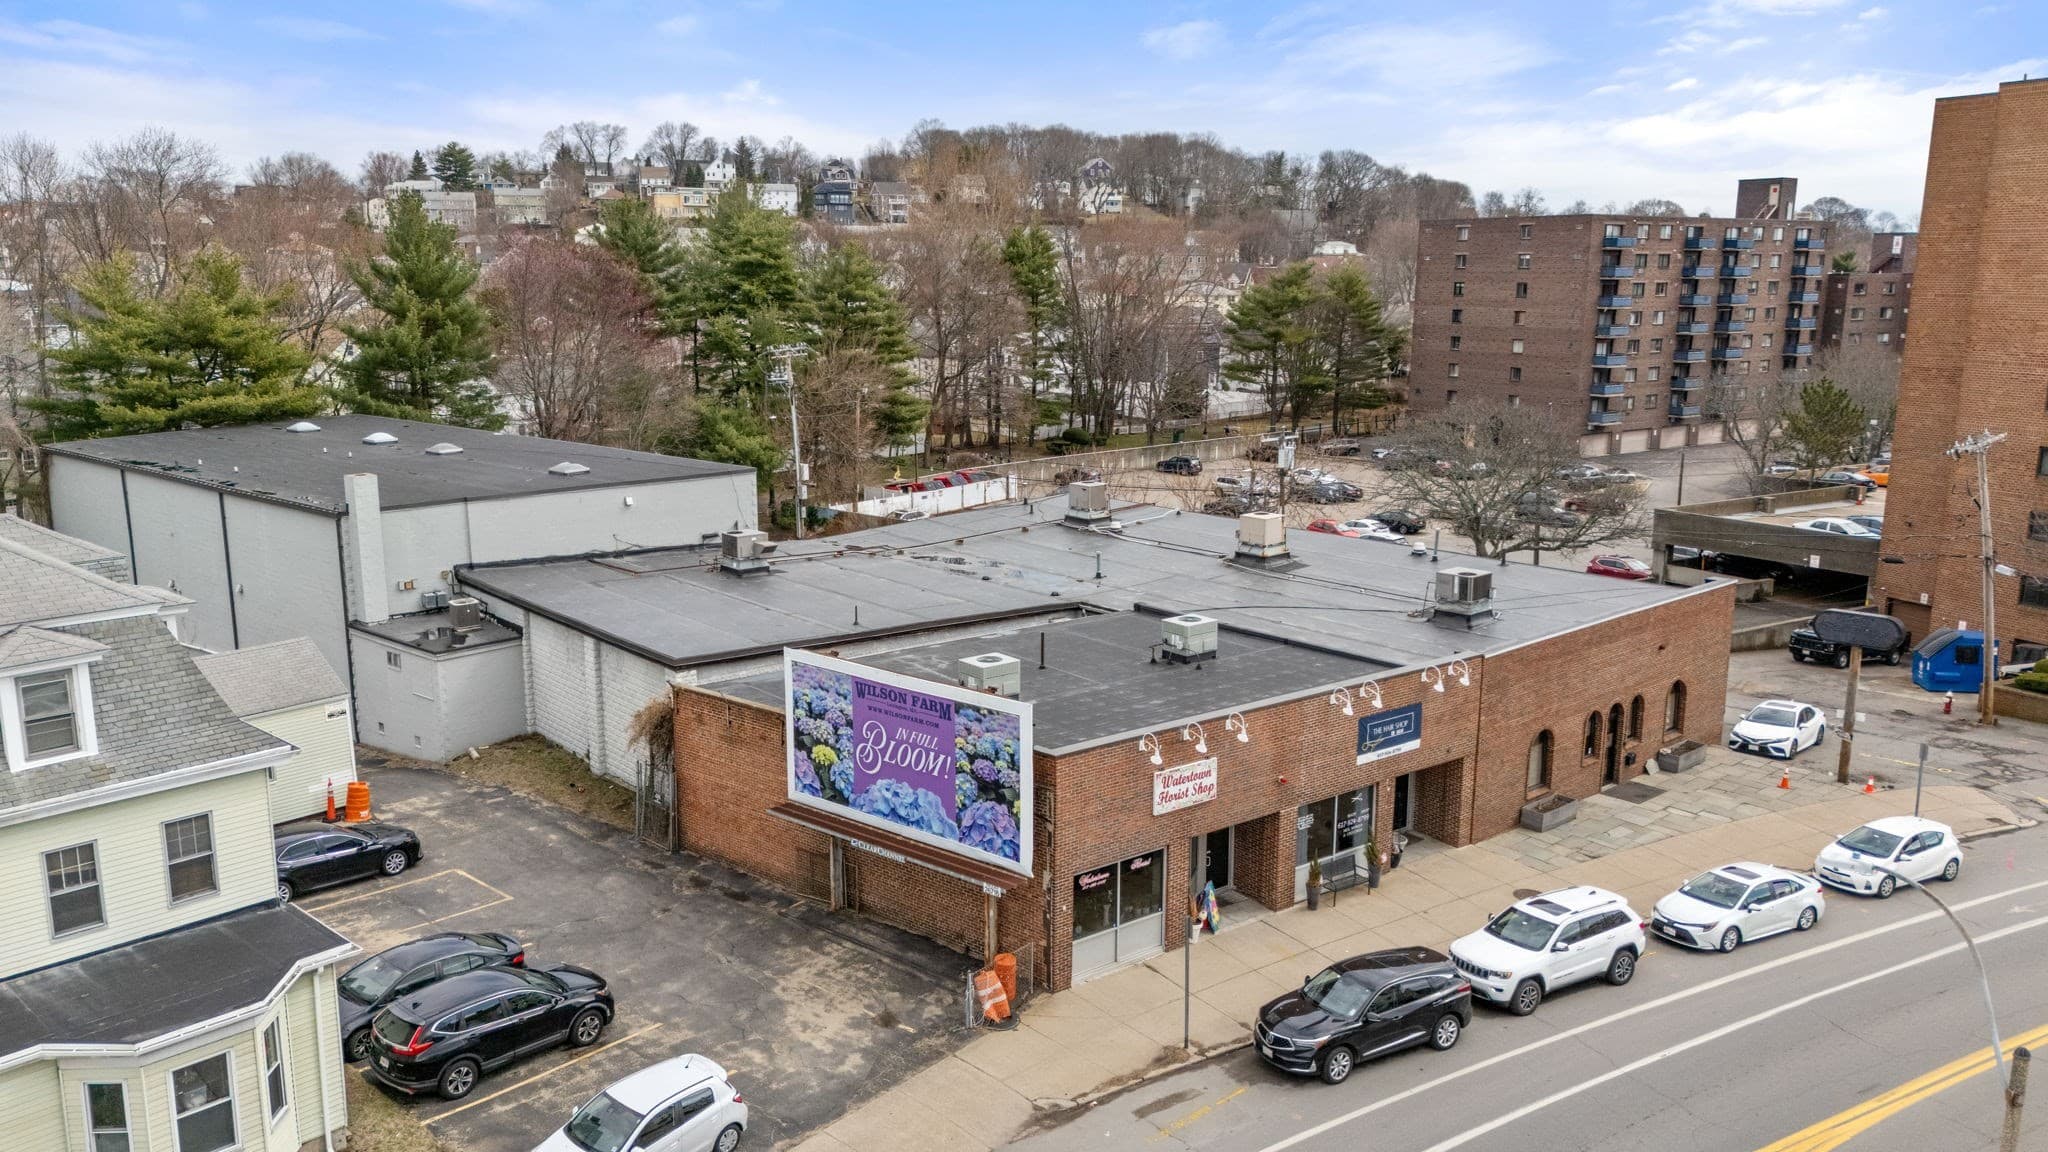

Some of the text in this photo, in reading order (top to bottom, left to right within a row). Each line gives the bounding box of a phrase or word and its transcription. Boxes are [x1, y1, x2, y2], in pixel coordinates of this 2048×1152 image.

[855, 681, 907, 704] WILSON
[911, 695, 952, 721] FARM
[895, 727, 938, 750] IN FULL
[1373, 727, 1382, 735] THE
[1395, 720, 1408, 729] SHOP
[856, 720, 951, 779] BLOOM!
[1162, 770, 1211, 789] Watertown
[1157, 787, 1189, 805] Florist
[1191, 782, 1215, 796] Shop
